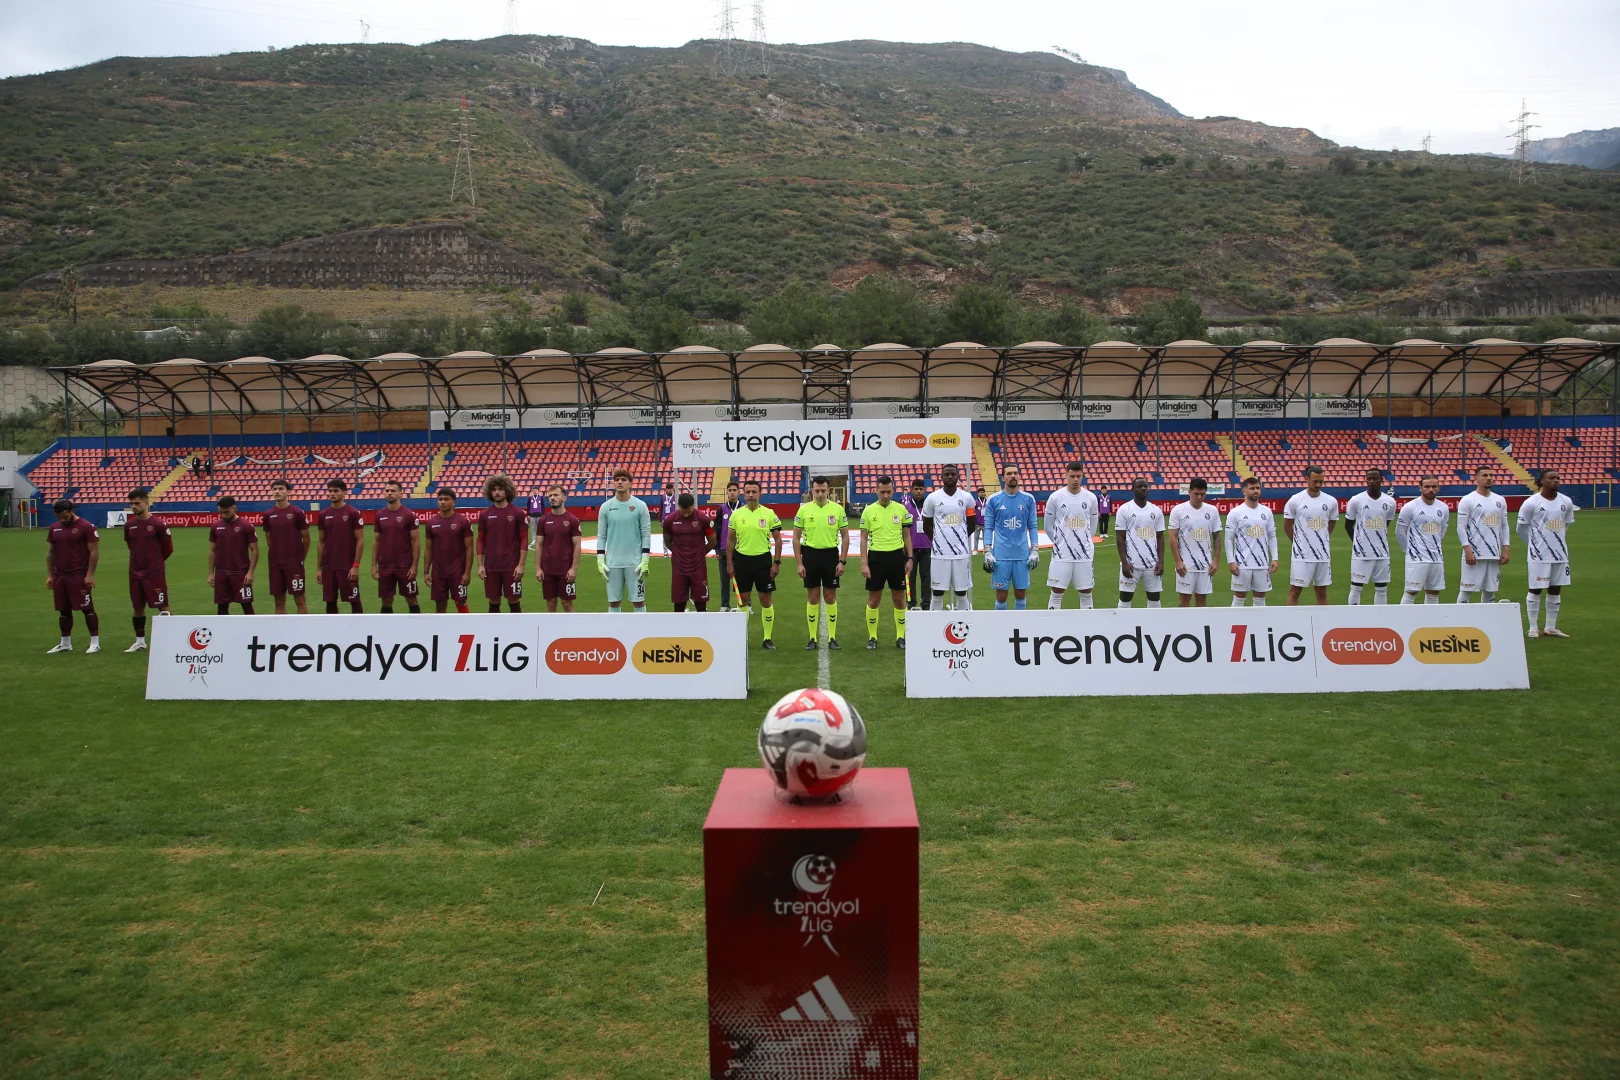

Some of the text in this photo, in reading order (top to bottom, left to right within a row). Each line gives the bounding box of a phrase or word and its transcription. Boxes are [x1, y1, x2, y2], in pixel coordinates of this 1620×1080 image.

[1071, 402, 1112, 413] Mngking
[723, 431, 832, 456] trendyol
[898, 434, 925, 444] trendyol
[683, 442, 711, 450] trendyol
[1565, 566, 1571, 576] 8
[292, 579, 304, 589] 95
[458, 584, 468, 595] 31
[511, 581, 522, 594] 15
[565, 583, 576, 594] 61
[158, 592, 164, 602] 6
[239, 587, 252, 598] 18
[352, 587, 358, 597] 9
[1008, 625, 1213, 671] trendyol
[1330, 638, 1396, 654] trendyol
[247, 634, 439, 680] trendyol
[554, 648, 619, 664] trendyol
[932, 647, 984, 659] trendyol
[175, 653, 223, 665] trendyol
[773, 898, 859, 918] trendyol
